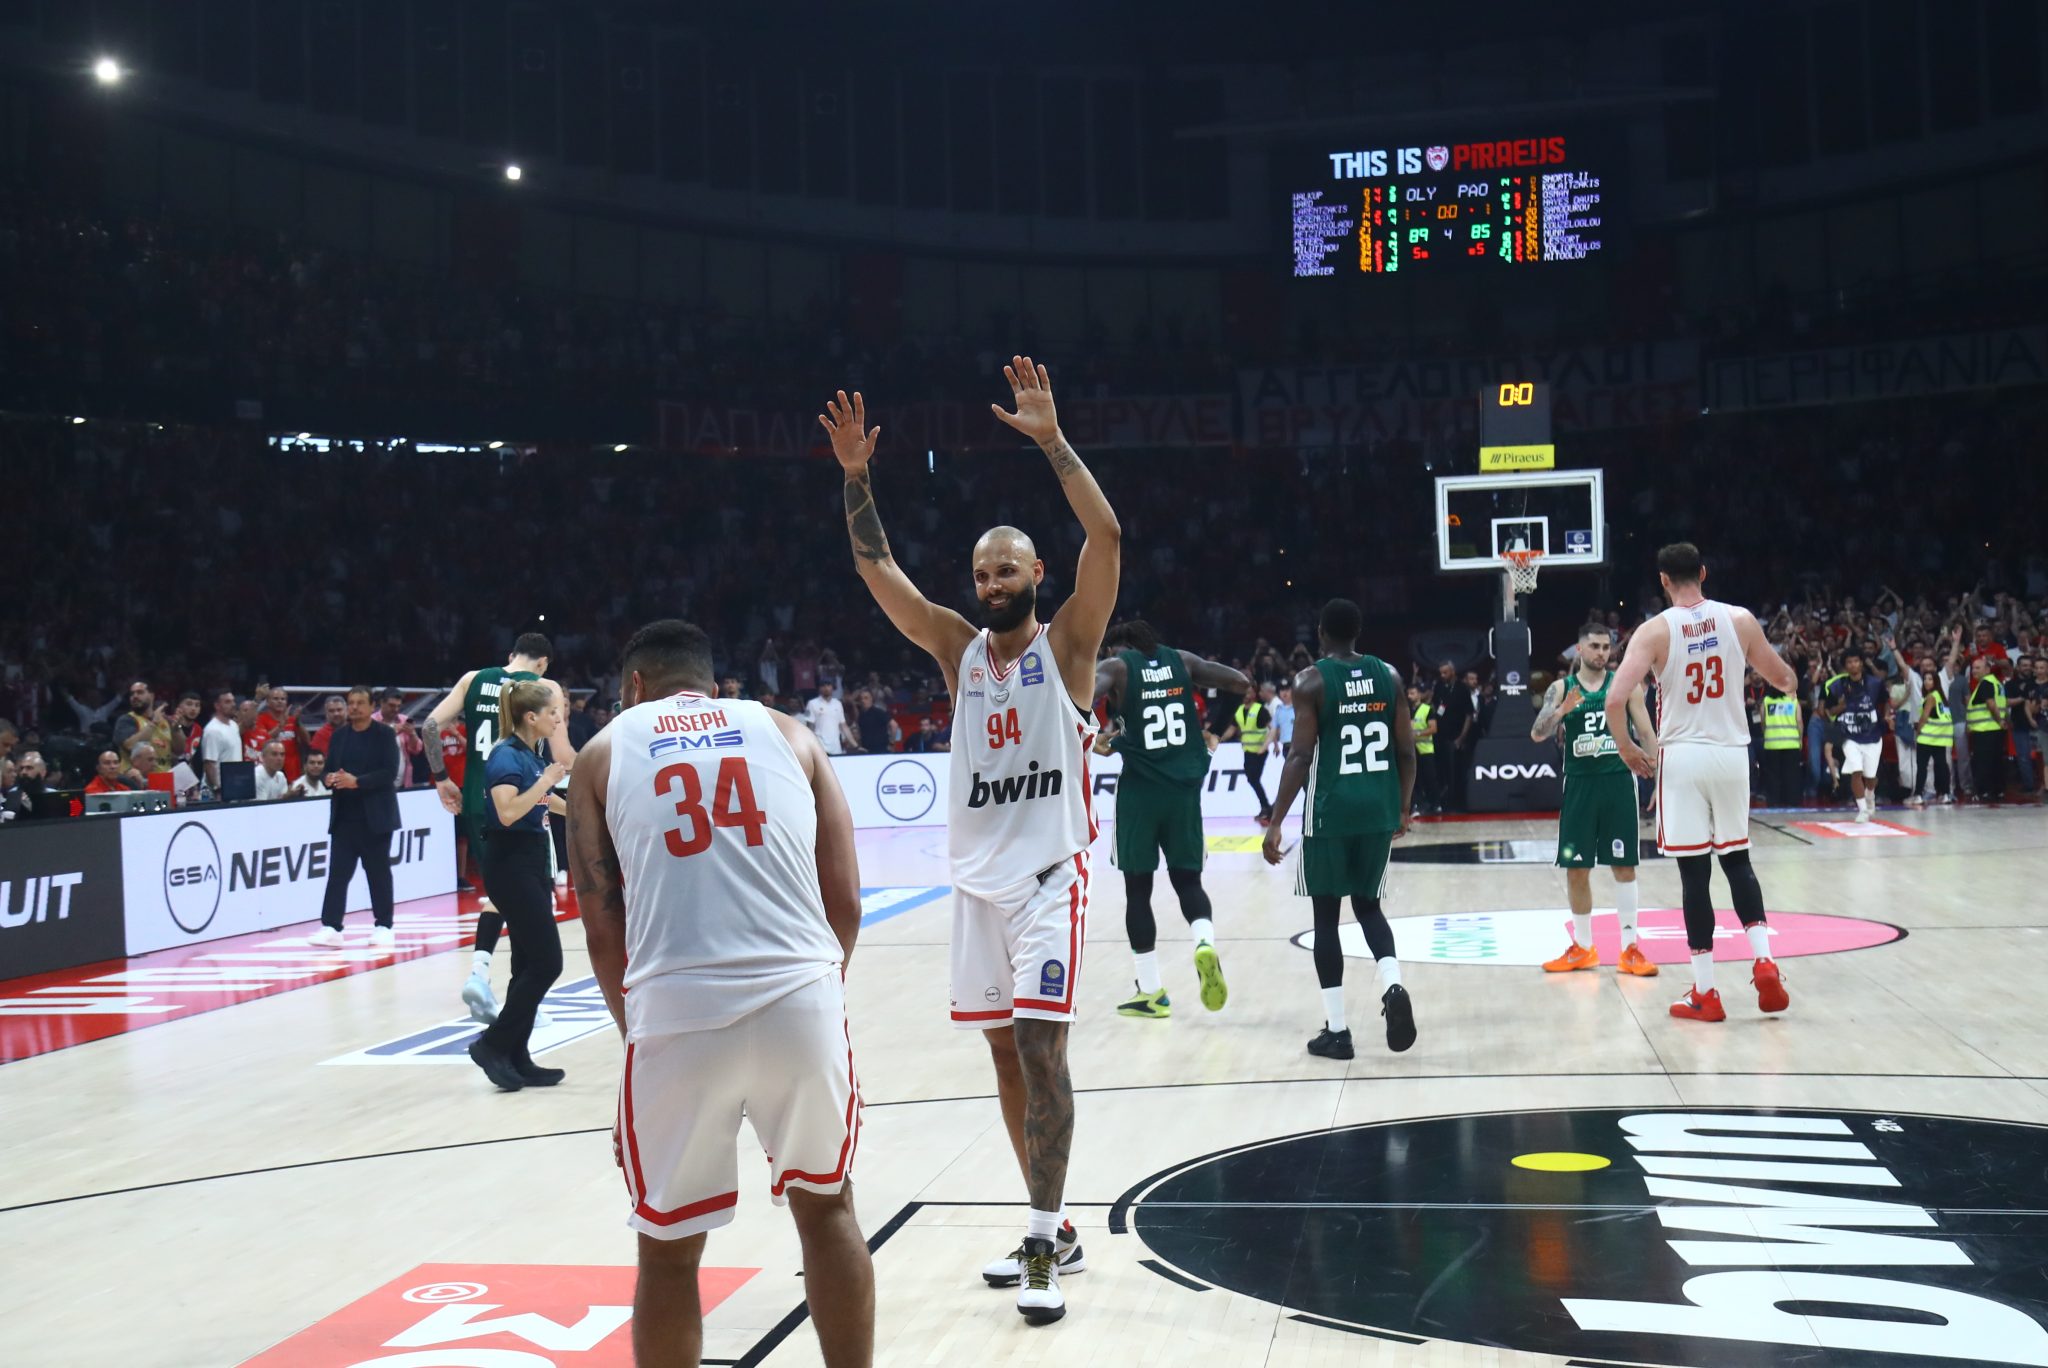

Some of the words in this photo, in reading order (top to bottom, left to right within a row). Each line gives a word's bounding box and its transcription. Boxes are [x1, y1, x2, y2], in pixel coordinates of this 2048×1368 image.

[1329, 150, 1388, 179] THIS
[1397, 147, 1422, 175] IS
[1406, 187, 1437, 202] OLY
[1457, 182, 1489, 198] PAO
[1409, 227, 1429, 243] 89
[1443, 228, 1452, 240] 4
[1470, 223, 1490, 239] 85
[1499, 383, 1533, 406] 0:0
[1503, 451, 1544, 464] Piraeus
[1345, 678, 1374, 697] GRANT
[1685, 656, 1724, 704] 33
[1141, 687, 1184, 700] instacar
[1339, 701, 1387, 714] instacar
[653, 709, 728, 734] JOSEPH
[986, 708, 1022, 749] 94
[1143, 702, 1187, 750] 26
[1584, 711, 1606, 732] 27
[475, 719, 496, 761] 4
[649, 729, 744, 759] FMS
[1339, 721, 1389, 775] 22
[1475, 763, 1557, 780] NOVA
[881, 783, 932, 796] GSA
[967, 760, 1063, 809] bwin
[654, 757, 767, 857] 34
[229, 841, 328, 892] NEVE
[389, 827, 431, 866] UIT
[169, 863, 218, 887] GSA
[0, 872, 84, 929] UIT
[1525, 1113, 2048, 1366] bwin
